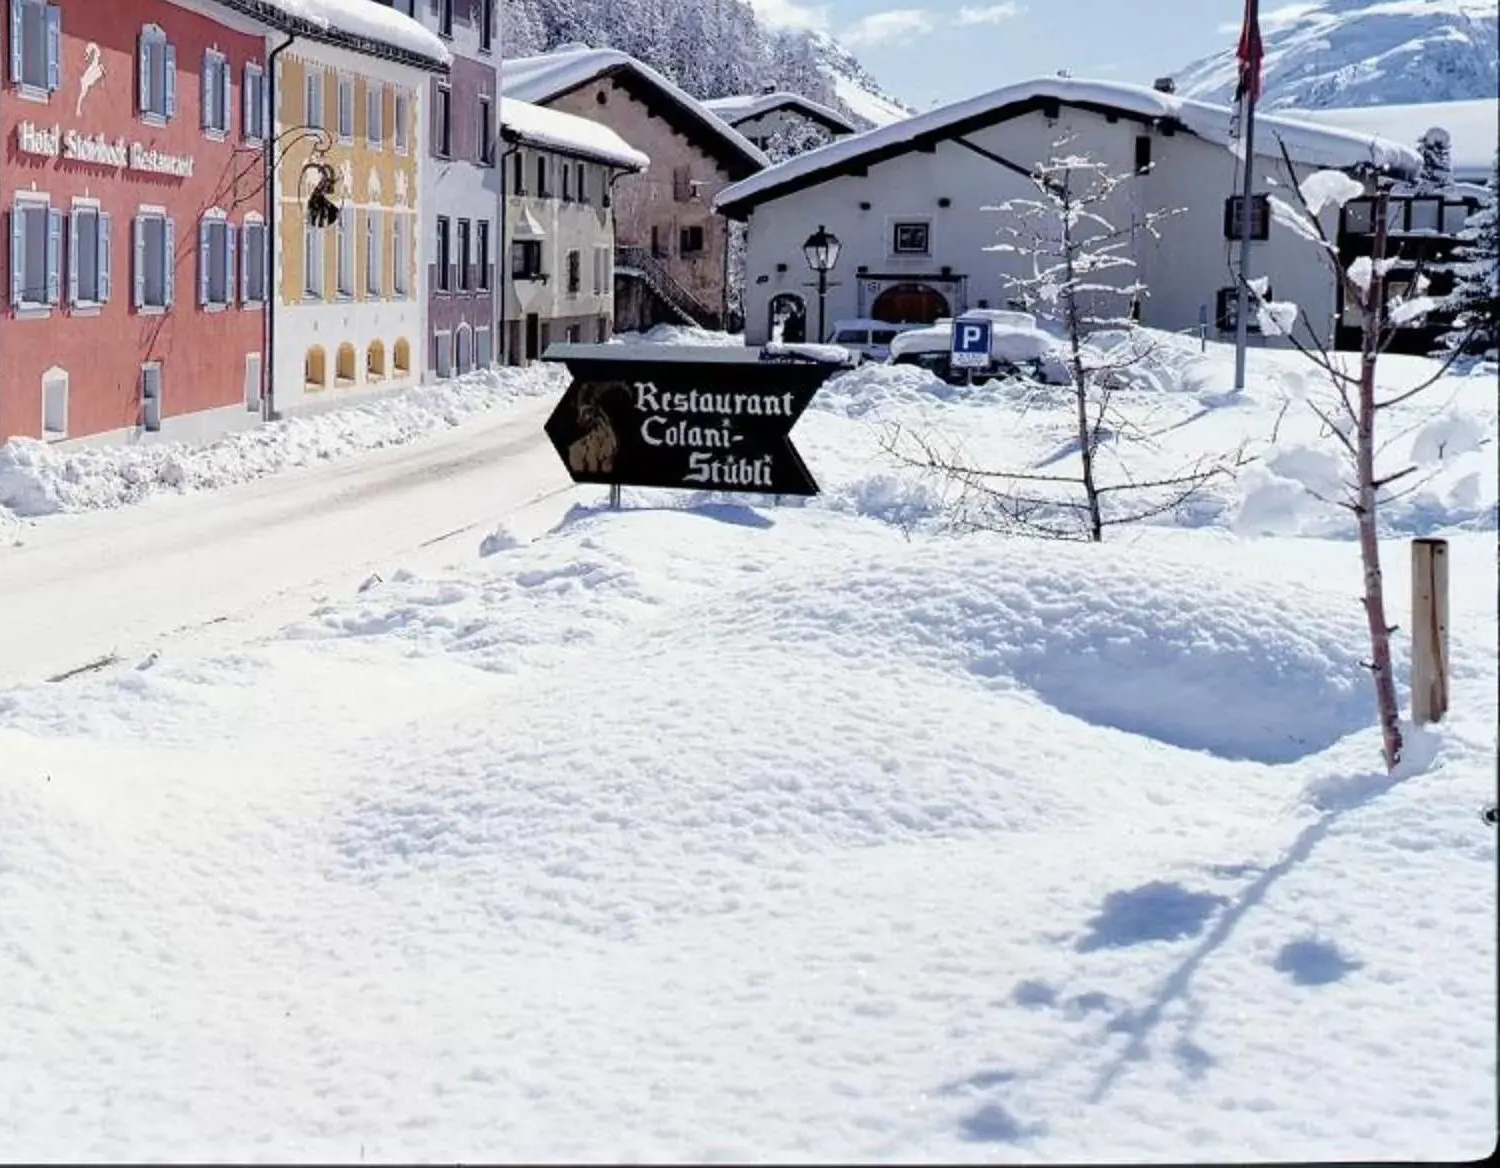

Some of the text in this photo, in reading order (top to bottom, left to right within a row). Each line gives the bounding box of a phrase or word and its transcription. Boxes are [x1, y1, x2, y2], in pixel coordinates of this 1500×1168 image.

[18, 119, 60, 156] Hotel
[963, 325, 981, 349] P
[633, 381, 794, 417] Restaurant
[640, 414, 744, 448] Colani-
